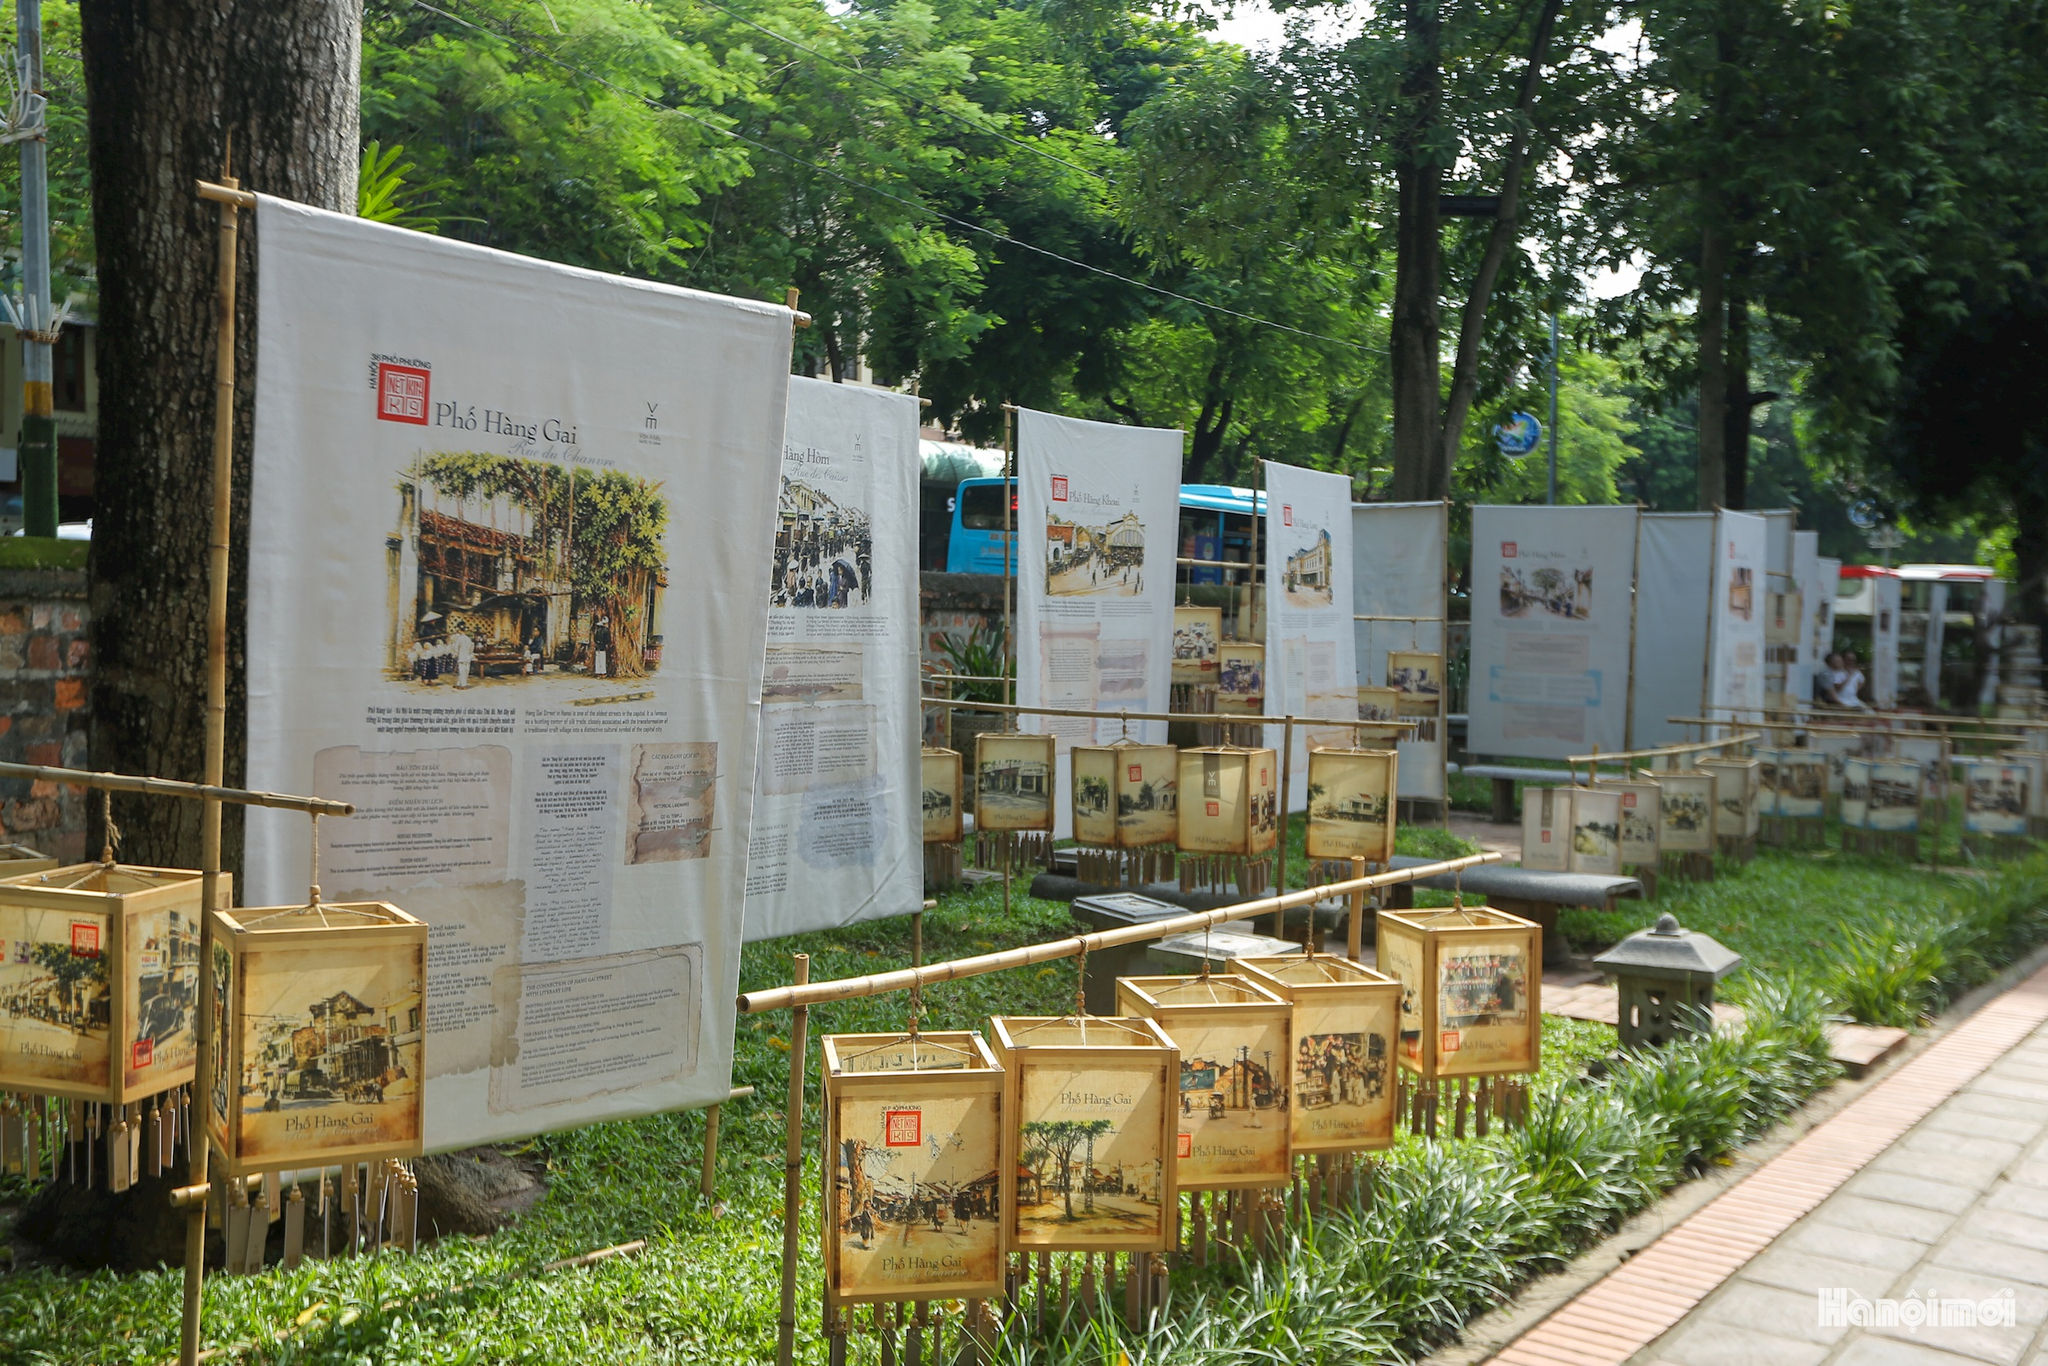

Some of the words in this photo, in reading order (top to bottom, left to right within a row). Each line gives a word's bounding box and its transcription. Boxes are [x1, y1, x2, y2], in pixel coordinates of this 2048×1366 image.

[435, 401, 477, 431] Phố
[484, 409, 538, 445] Hàng
[543, 418, 577, 445] Gai
[807, 448, 830, 465] Hòm
[1061, 1091, 1081, 1104] Phố
[1084, 1093, 1111, 1106] Hàng
[1114, 1093, 1132, 1104] Gai
[286, 1115, 311, 1131] Phố
[315, 1114, 348, 1129] Hàng
[352, 1112, 374, 1125] Gai
[1193, 1145, 1210, 1157] Phố
[1213, 1145, 1237, 1156] Hàng
[1239, 1145, 1256, 1156] Gai
[882, 1256, 905, 1270] Phố
[909, 1256, 939, 1271] Hàng
[941, 1255, 962, 1267] Gai
